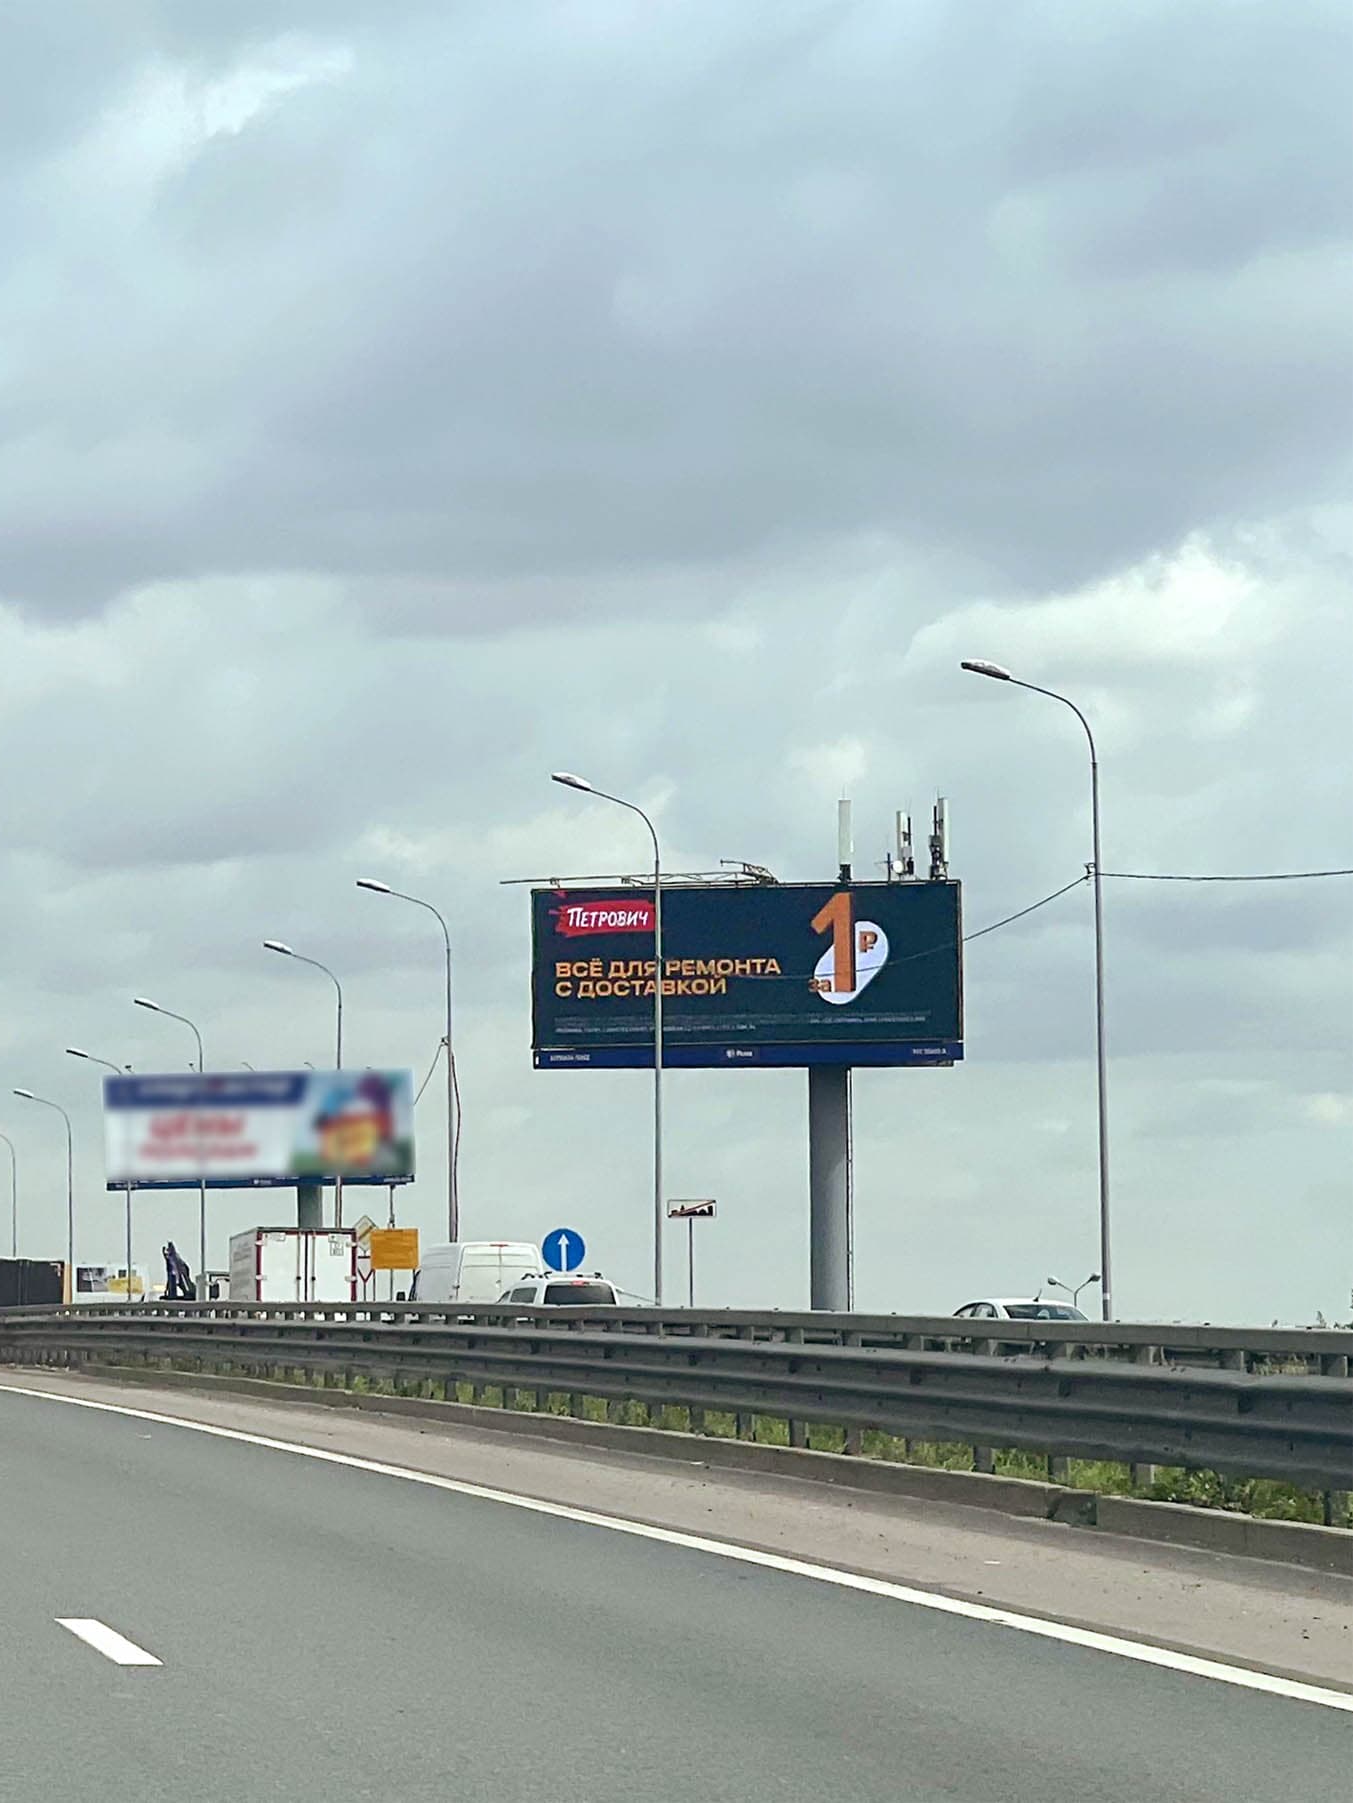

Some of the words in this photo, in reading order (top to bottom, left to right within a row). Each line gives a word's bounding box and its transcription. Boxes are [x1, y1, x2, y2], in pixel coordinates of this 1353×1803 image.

[555, 958, 603, 978] ВСЁ
[608, 960, 657, 979] ДЛЯ
[665, 957, 781, 976] РЕМОНТА
[555, 980, 572, 997] С
[577, 973, 727, 999] ДОСТАВКОЙ
